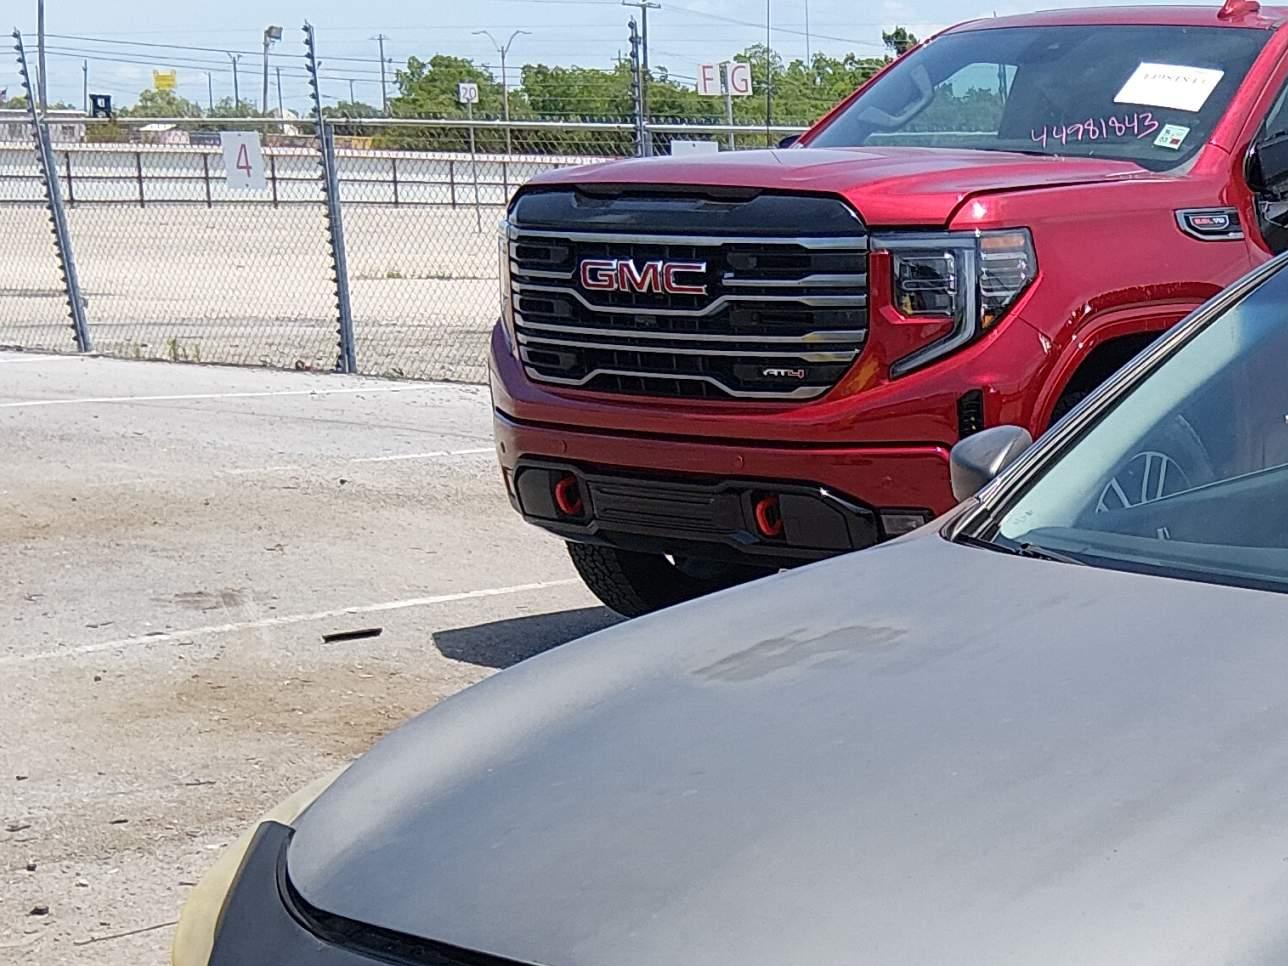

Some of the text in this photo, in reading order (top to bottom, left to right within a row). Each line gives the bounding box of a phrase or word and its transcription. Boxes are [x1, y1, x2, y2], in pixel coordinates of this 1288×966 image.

[460, 86, 477, 100] 20
[701, 64, 714, 93] F
[731, 64, 749, 93] G
[1031, 113, 1159, 148] 44981843
[236, 143, 252, 177] 4
[580, 258, 708, 295] GMC
[762, 367, 805, 379] AT4
